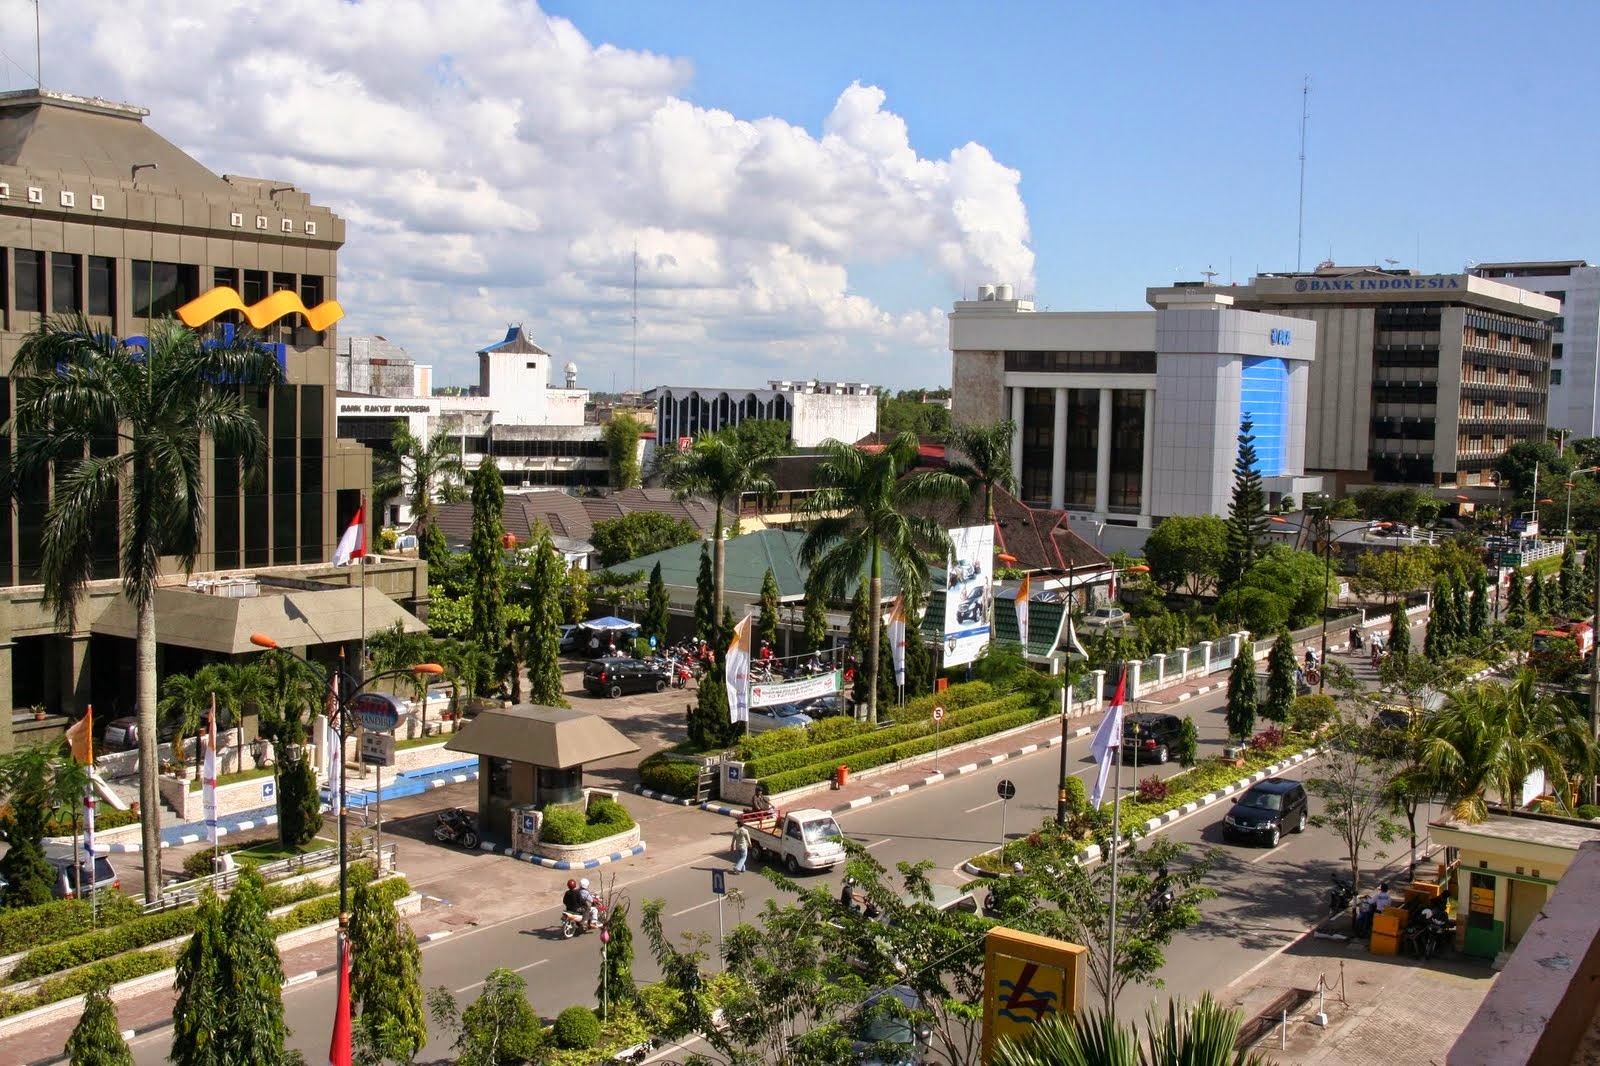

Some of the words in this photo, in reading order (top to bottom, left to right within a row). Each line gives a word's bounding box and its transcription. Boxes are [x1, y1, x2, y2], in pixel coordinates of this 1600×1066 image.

[1311, 279, 1355, 291] BANK
[1360, 278, 1459, 290] INDONESIA
[341, 405, 362, 413] BANK
[364, 405, 392, 413] RAKYAT
[394, 405, 430, 413] INDONESIA
